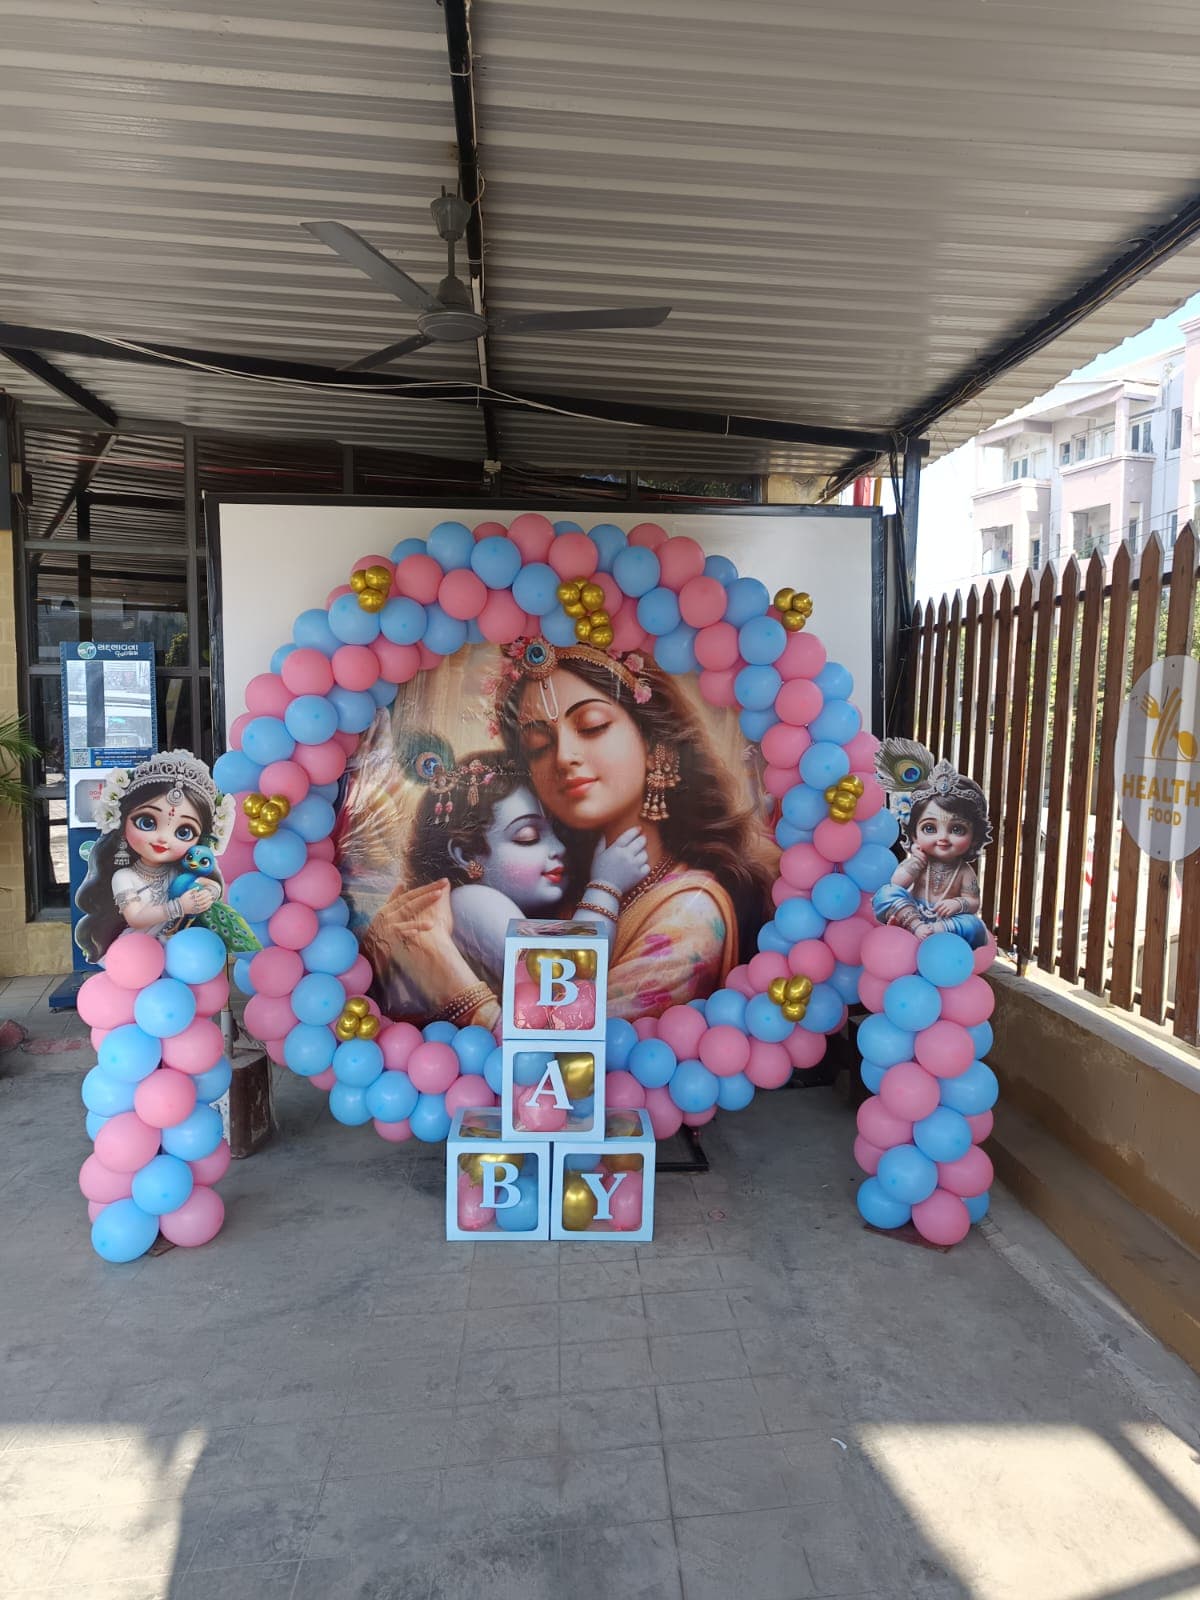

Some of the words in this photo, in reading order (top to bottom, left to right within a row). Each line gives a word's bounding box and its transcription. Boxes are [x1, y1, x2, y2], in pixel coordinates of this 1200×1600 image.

[1147, 806, 1182, 826] FOOD
[536, 957, 580, 1007] B
[525, 1059, 574, 1111] A
[479, 1160, 522, 1210] B
[581, 1172, 628, 1221] Y
